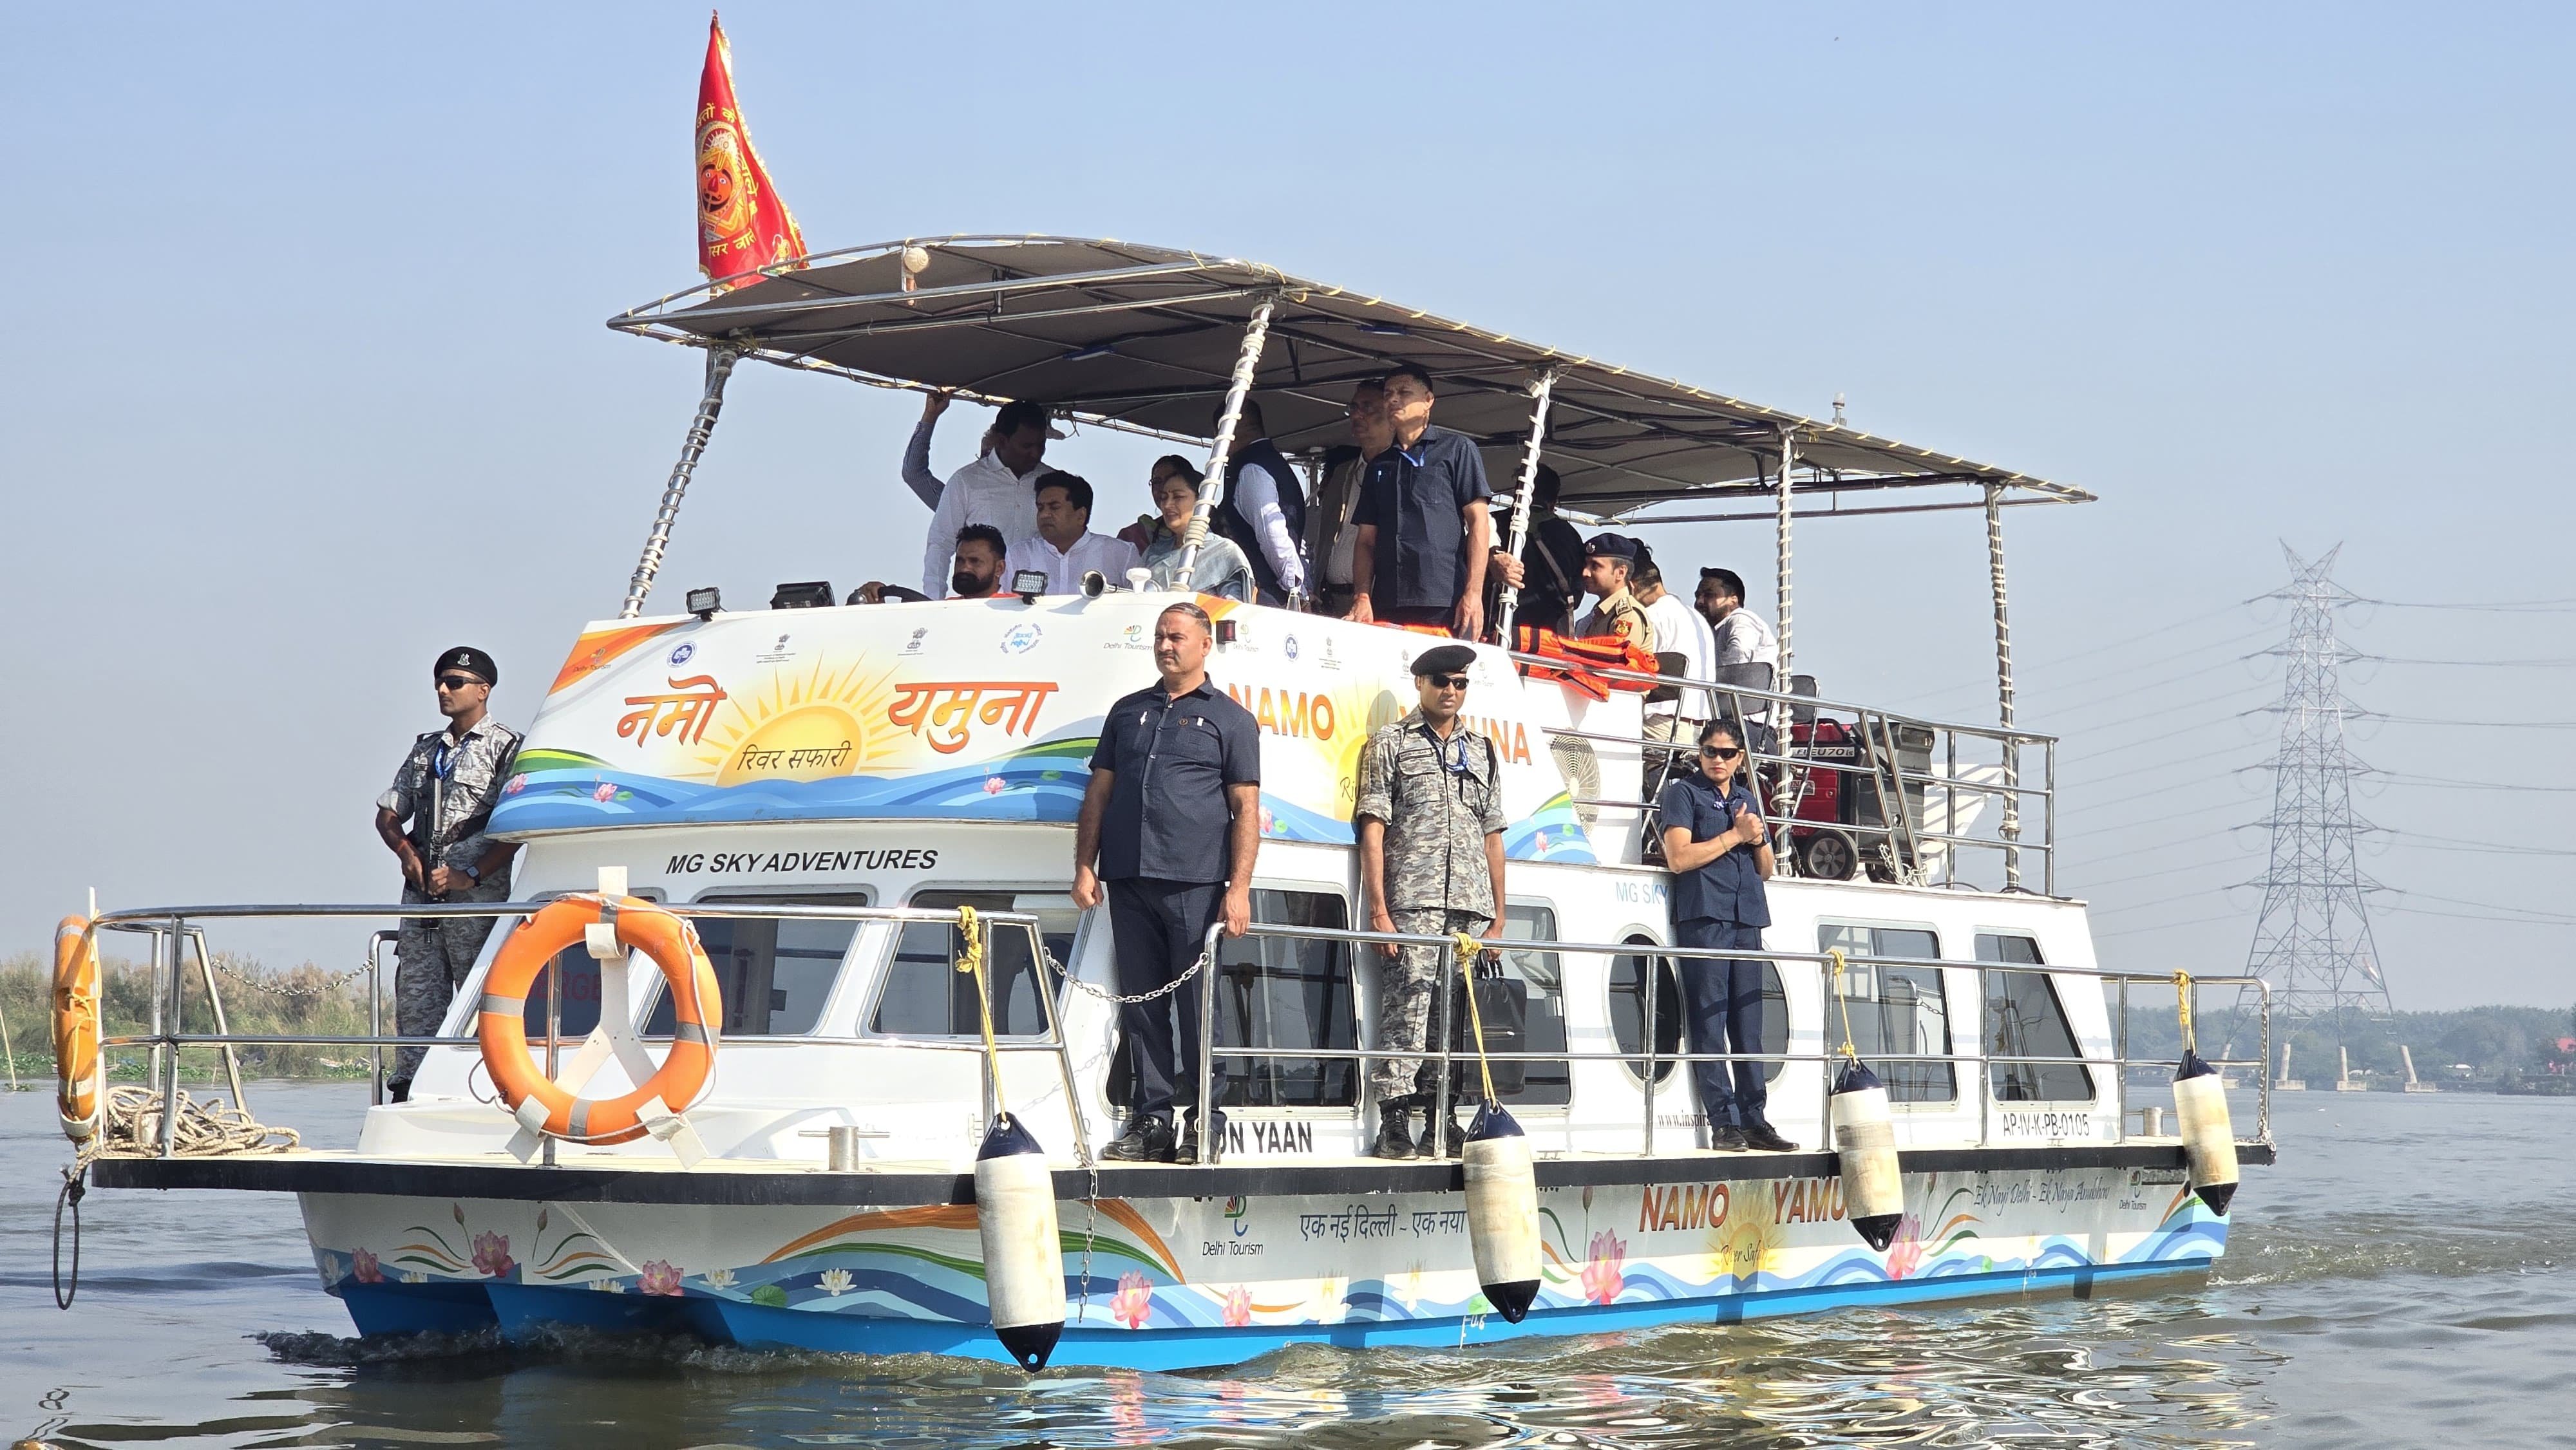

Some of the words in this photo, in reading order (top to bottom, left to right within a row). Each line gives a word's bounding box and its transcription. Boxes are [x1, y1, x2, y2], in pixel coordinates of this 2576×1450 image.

[1124, 643, 1153, 651] Tourism
[616, 674, 728, 748] नमो
[888, 681, 1059, 754] यमुना
[737, 745, 786, 771] रिवर
[788, 740, 852, 771] सफारी
[665, 853, 705, 874] MG
[709, 852, 764, 873] SKY
[762, 849, 938, 872] ADVENTURES
[1616, 881, 1638, 903] MG
[1643, 883, 1668, 905] SKY
[1252, 1122, 1312, 1153] YAAN
[2003, 1113, 2089, 1136] AP-IV-K-PB-0105
[1639, 1183, 1730, 1232] NAMO
[1774, 1178, 1850, 1225] YAMU
[1974, 1180, 1989, 1208] Ek
[1988, 1185, 2011, 1216] Nayi
[2011, 1179, 2032, 1204] Delhi
[2038, 1179, 2053, 1205] Ek
[2052, 1182, 2074, 1214] Naya
[2074, 1176, 2112, 1202] Anubhav
[2119, 1200, 2130, 1210] Delhi
[2132, 1200, 2147, 1210] Tourism
[1300, 1214, 1328, 1241] एक
[1331, 1204, 1353, 1243] नई
[1354, 1203, 1397, 1239] दिल्ली
[1412, 1212, 1437, 1239] एक
[1440, 1210, 1467, 1234] नया
[1202, 1240, 1226, 1256] Delhi
[1229, 1241, 1264, 1256] Tourism
[1721, 1245, 1743, 1266] River
[1743, 1239, 1770, 1267] Safari
